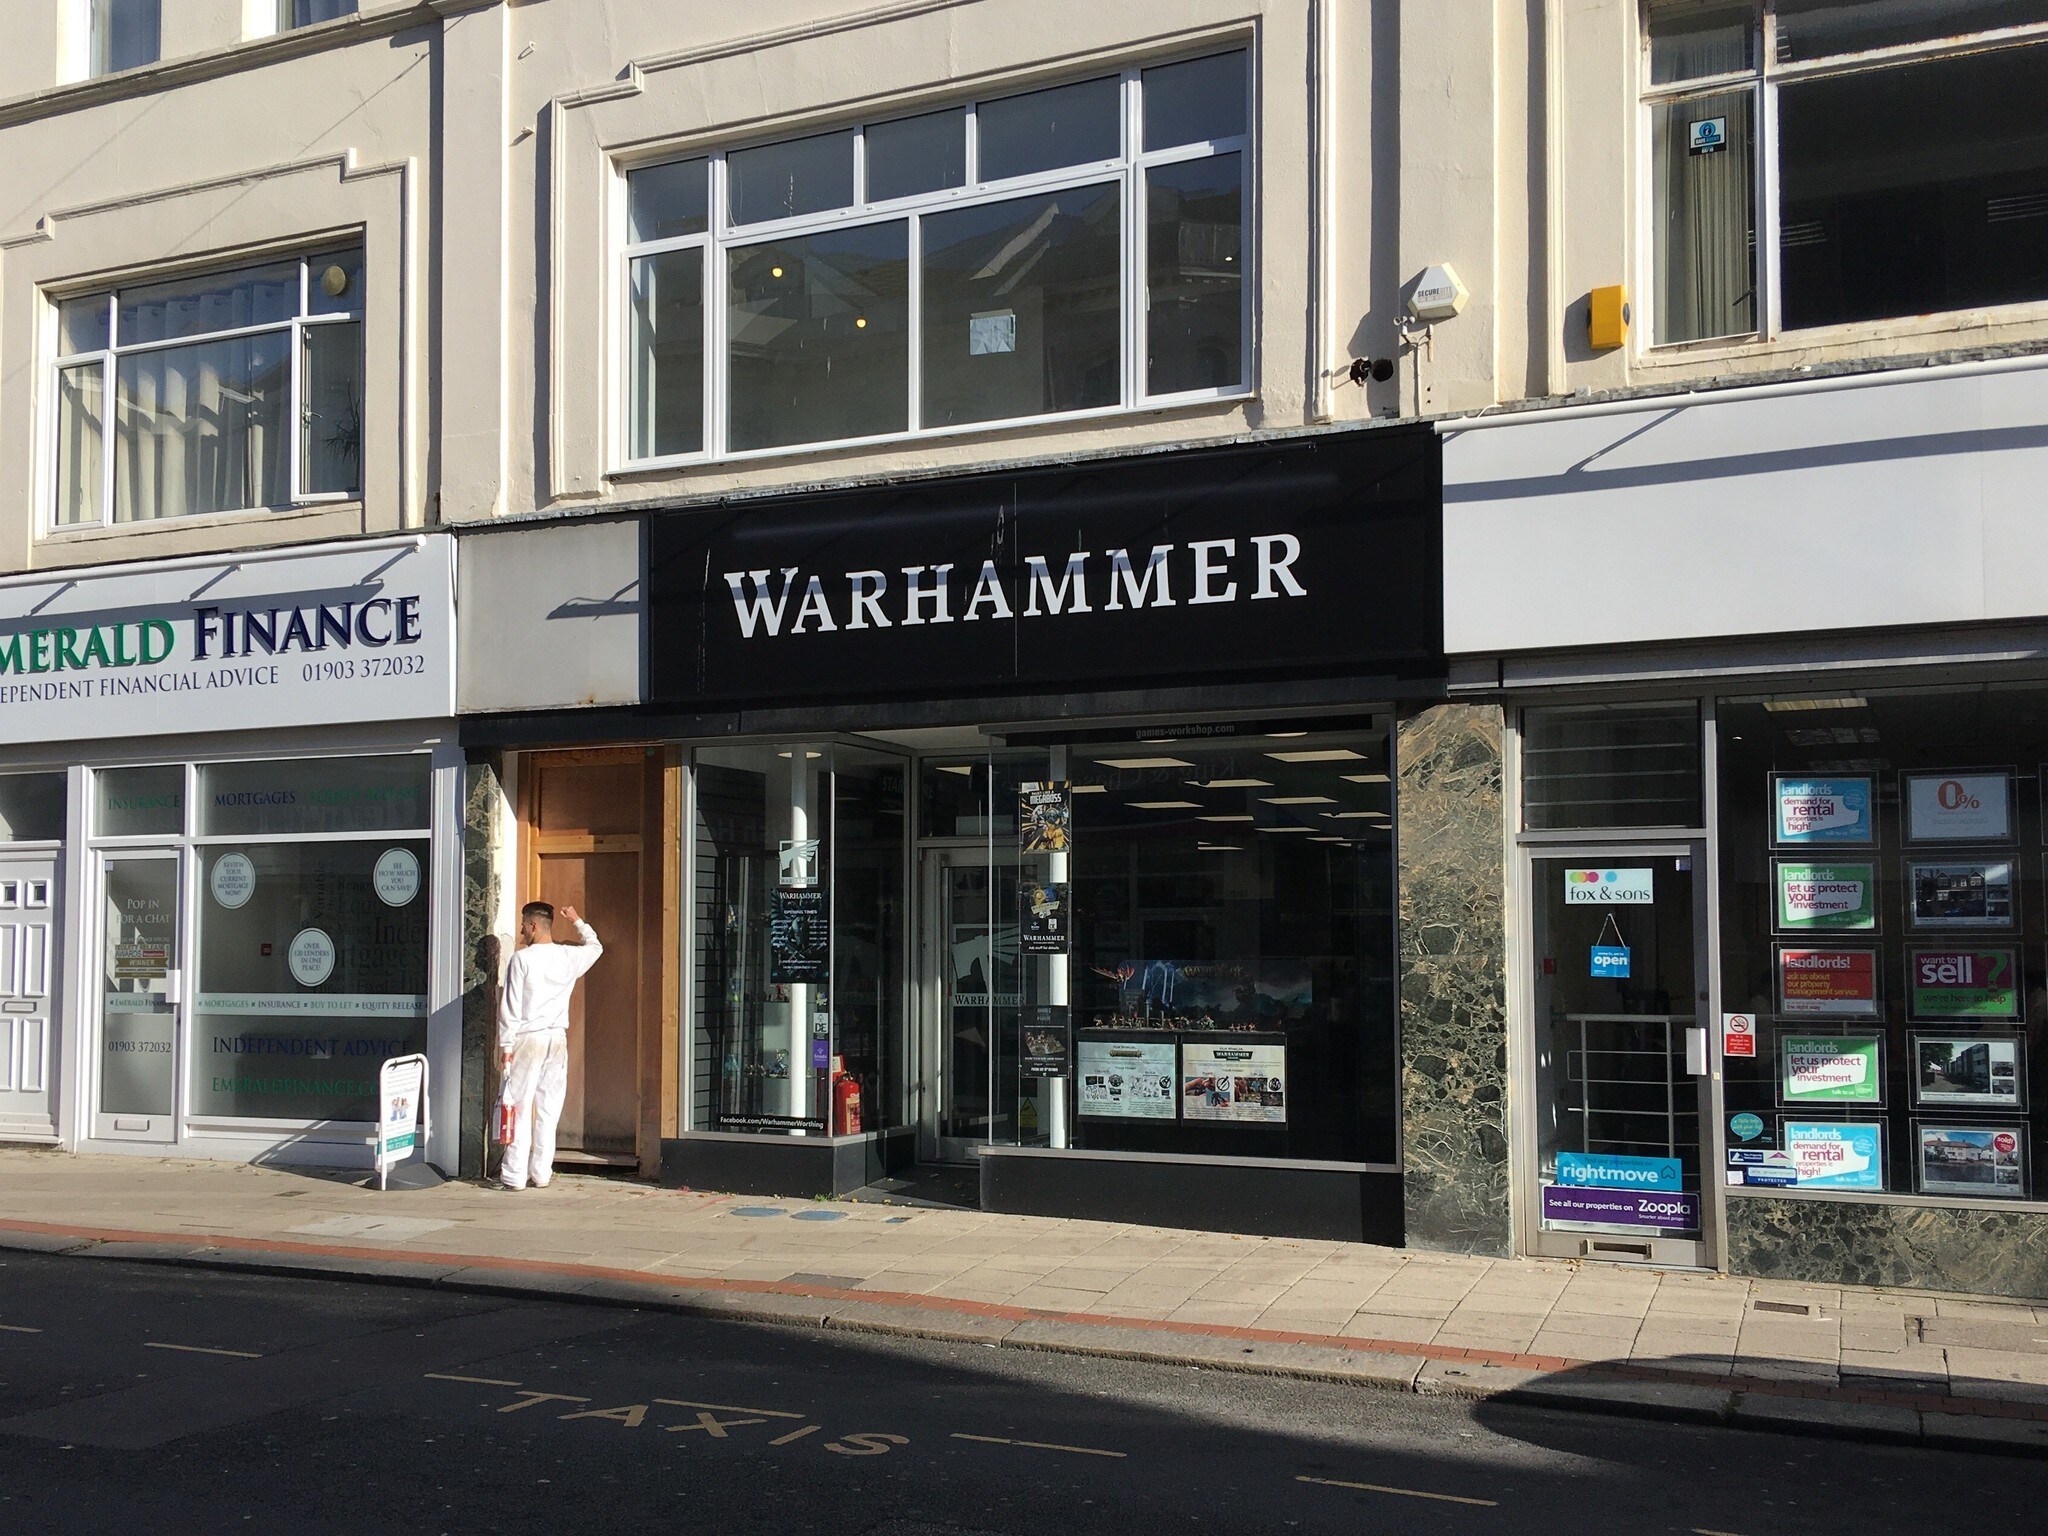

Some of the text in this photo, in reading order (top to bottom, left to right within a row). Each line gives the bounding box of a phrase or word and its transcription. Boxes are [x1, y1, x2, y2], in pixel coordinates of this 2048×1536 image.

[723, 532, 1308, 639] WARHAMMER
[192, 595, 422, 660] FINANCE
[100, 672, 200, 697] FINANCIAL
[206, 665, 279, 689] ADVICE
[302, 660, 355, 682] 01903
[360, 654, 425, 678] 372032
[1136, 725, 1235, 739] games-workshop.com
[1782, 783, 1832, 795] landlords
[1938, 780, 1980, 810] 0%
[107, 795, 181, 811] INSURANCE
[214, 790, 297, 808] MORTGAGES
[1030, 793, 1062, 805] MEGABOSS
[1784, 797, 1817, 805] demand
[1793, 803, 1834, 816] rental
[1788, 822, 1811, 832] high!
[1784, 868, 1835, 880] landlords
[1570, 886, 1651, 901] fox & sons
[1787, 883, 1858, 895] let us protect
[780, 892, 822, 900] WARHAMMER
[1788, 893, 1816, 904] your
[127, 899, 159, 909] POP IN
[1794, 901, 1848, 909] investment
[136, 914, 143, 923] A
[144, 914, 170, 924] CHAT
[1593, 956, 1628, 967] open
[1786, 955, 1851, 968] landlords!
[1922, 956, 1973, 984] sell
[115, 999, 144, 1007] EMERALD
[205, 1000, 423, 1010] MORTGAGES INSURANCE BUY TO LET EQUITY RELEASE
[955, 994, 1025, 1005] WARHAMMER
[108, 1041, 171, 1053] 01903 372032
[212, 1036, 408, 1056] INDEPENDENT ADVICE
[1787, 1041, 1838, 1053] landlords
[1791, 1055, 1861, 1067] let us protect
[1792, 1065, 1819, 1076] your
[1797, 1074, 1852, 1082] investment
[720, 1117, 824, 1130] Facebook.com/WarhammerWorthing
[1790, 1127, 1842, 1140] landlords
[1997, 1135, 2014, 1144] sold!
[1828, 1142, 1840, 1150] for
[1802, 1148, 1844, 1161] rental
[1562, 1163, 1659, 1182] rightmove
[1798, 1167, 1821, 1178] high!
[1549, 1199, 1563, 1207] See
[1586, 1202, 1622, 1211] properties
[1638, 1199, 1691, 1216] Zoopla
[496, 1390, 911, 1456] TAXIS
